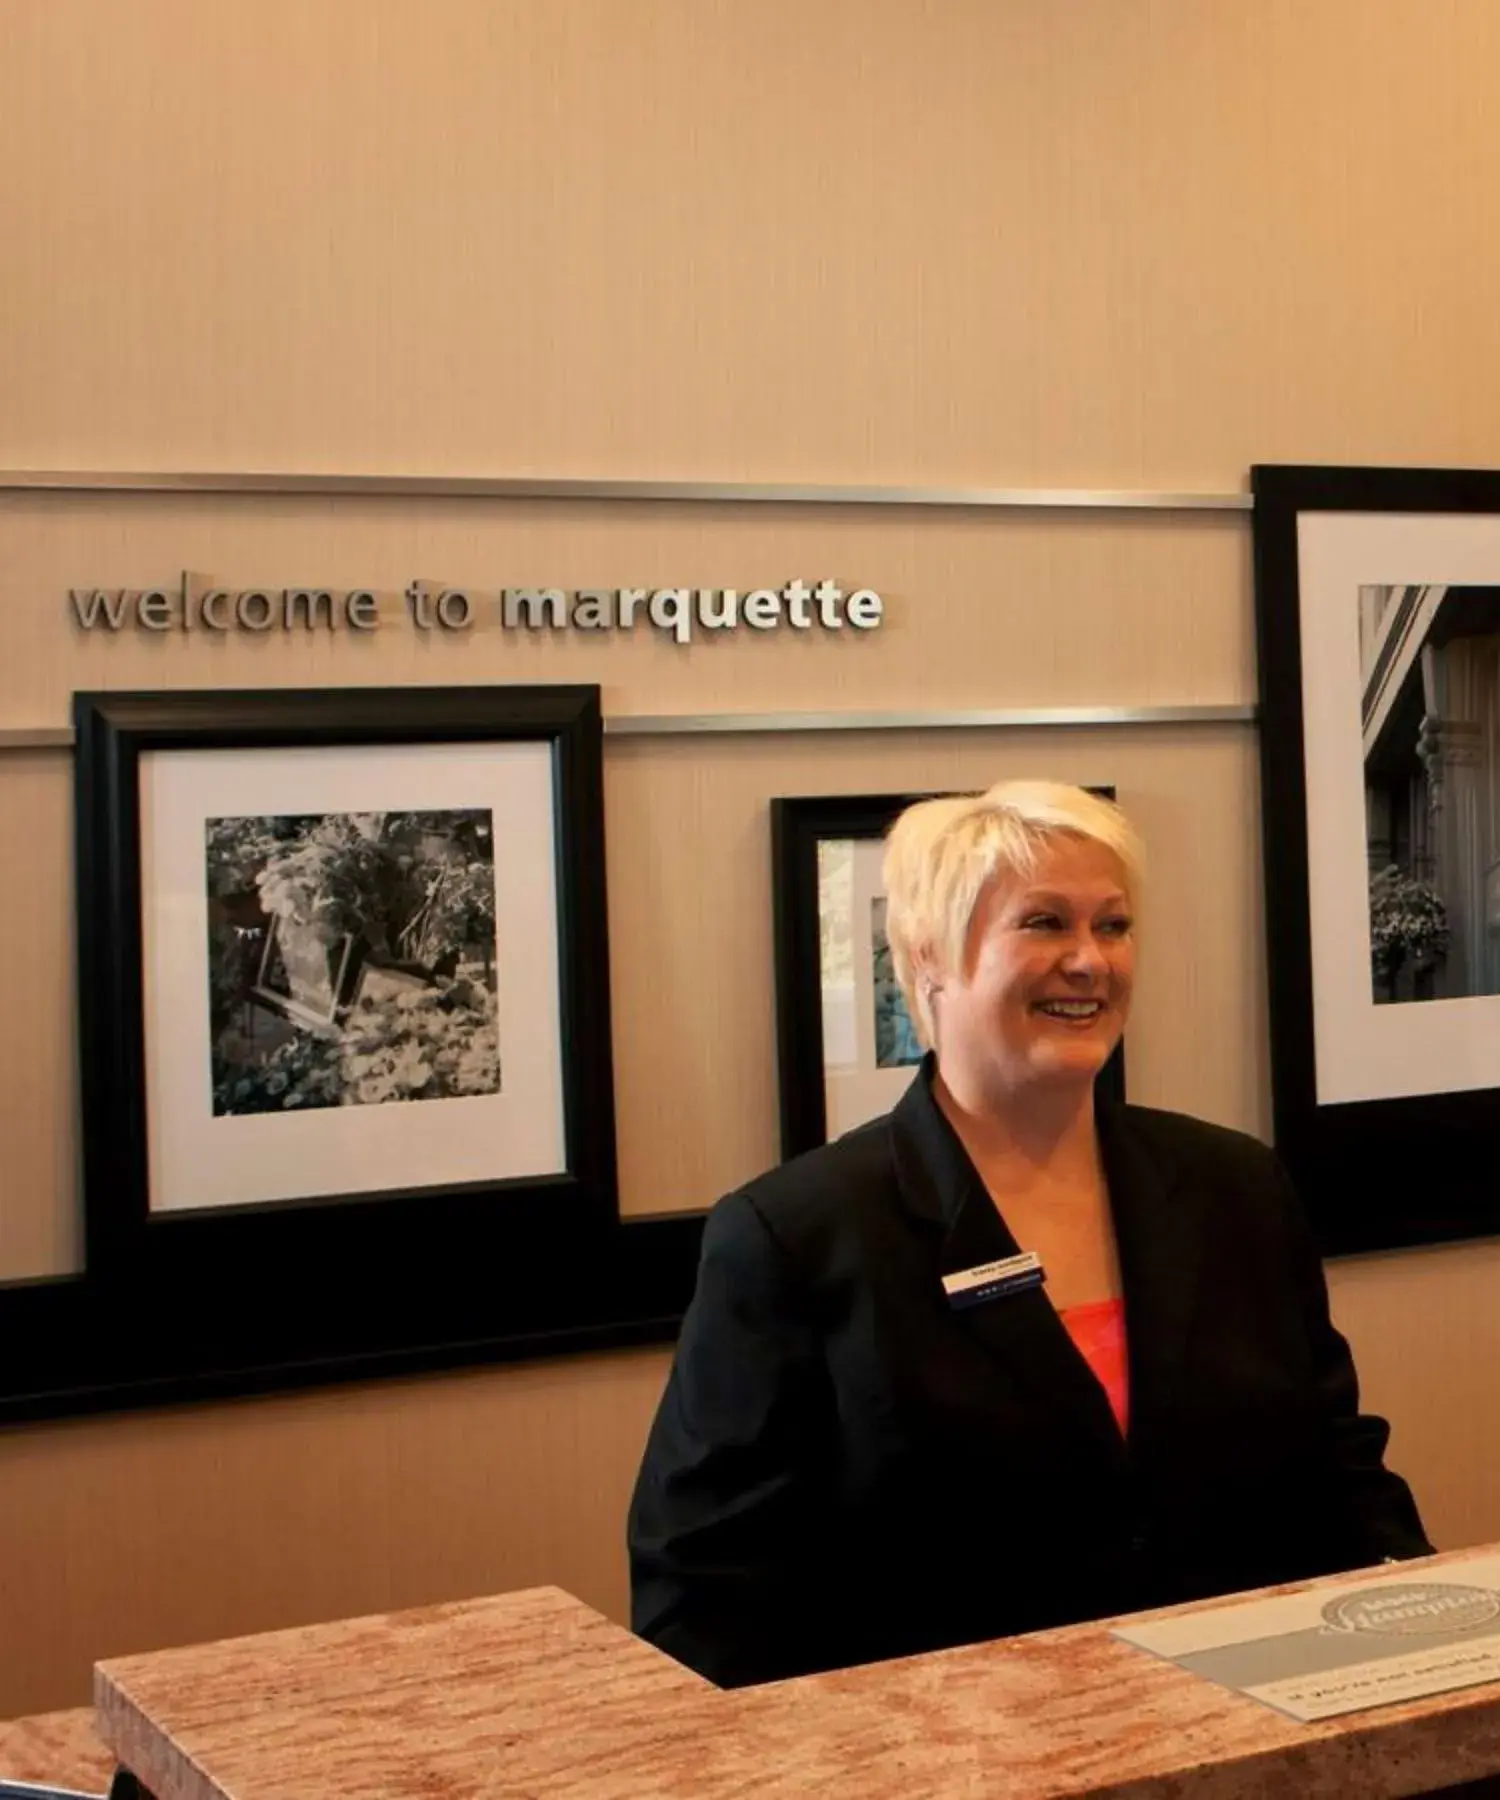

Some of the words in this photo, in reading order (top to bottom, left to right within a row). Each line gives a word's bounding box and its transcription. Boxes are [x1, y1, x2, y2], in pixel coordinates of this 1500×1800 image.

[69, 570, 377, 631] welcome
[406, 578, 476, 631] to
[501, 578, 884, 644] marquette
